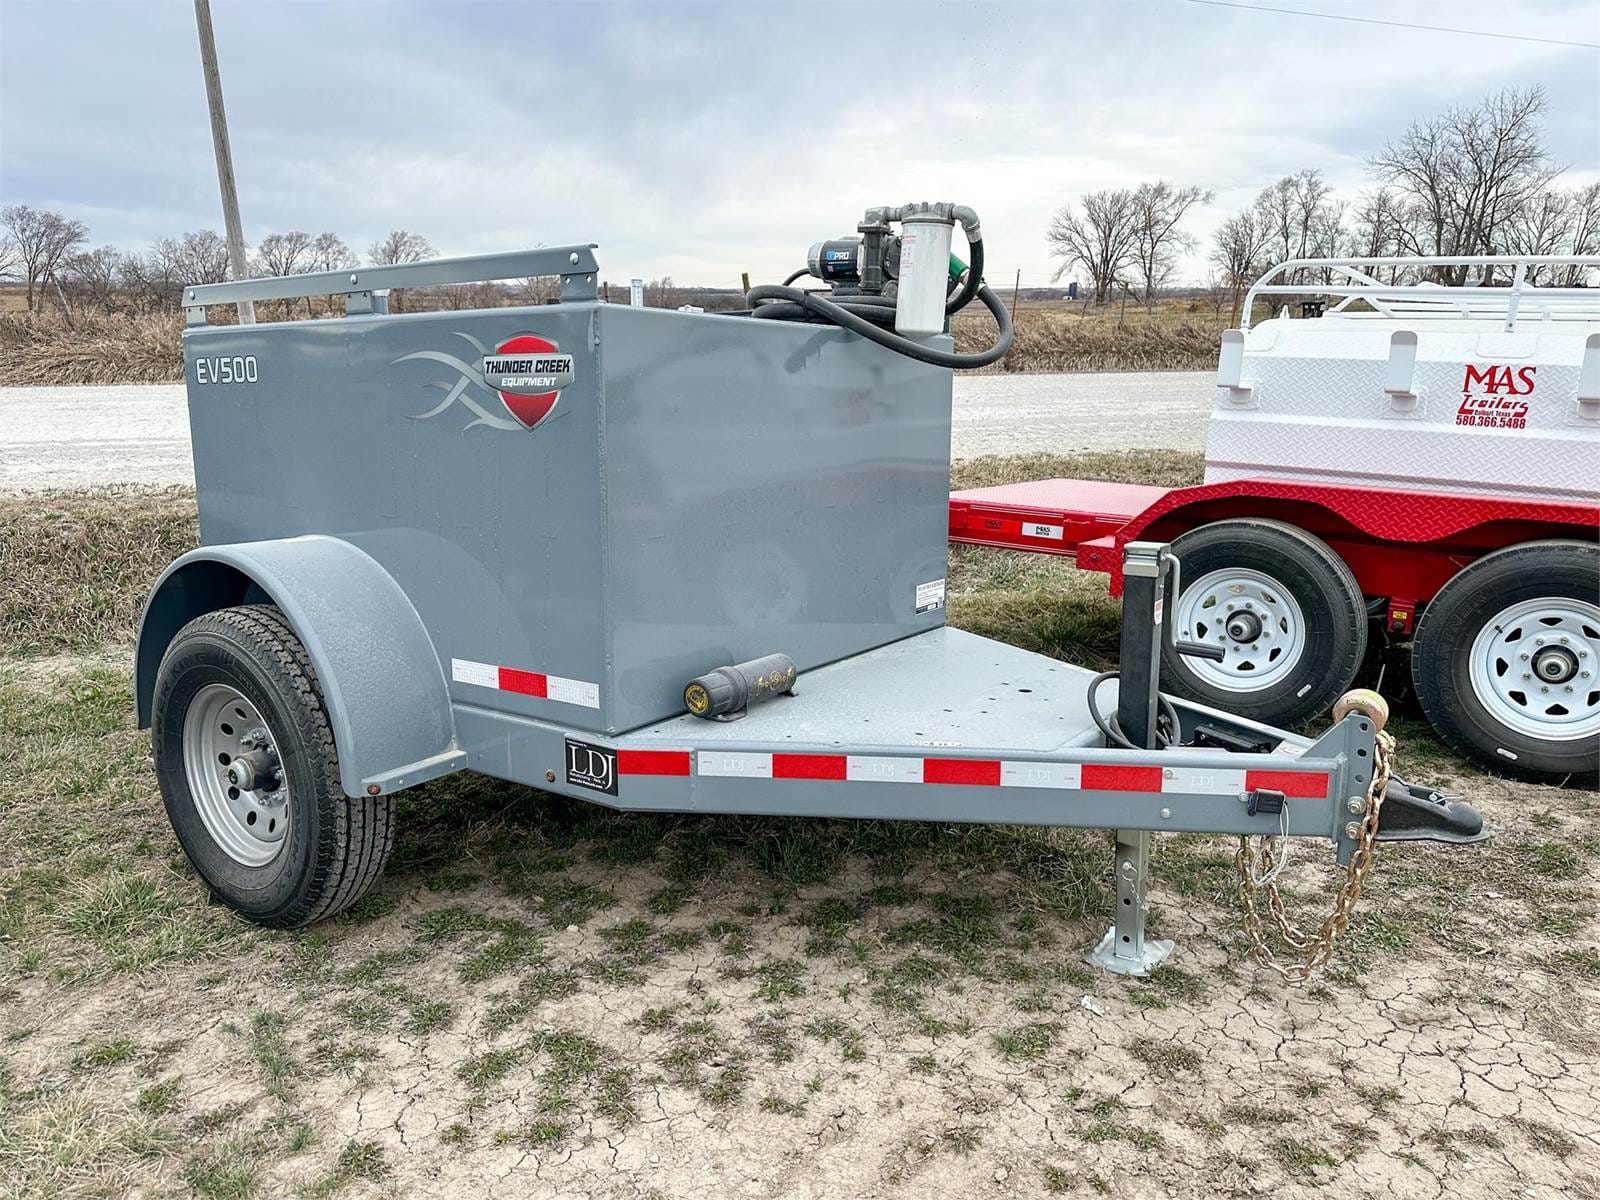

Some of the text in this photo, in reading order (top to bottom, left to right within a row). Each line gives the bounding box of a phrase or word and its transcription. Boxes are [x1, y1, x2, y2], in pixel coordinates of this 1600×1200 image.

[195, 355, 259, 385] EV500
[485, 358, 572, 375] THUNDER CREEK
[501, 376, 557, 388] EQUIPMENT
[1461, 364, 1537, 396] MAS
[1457, 394, 1530, 418] Trailers
[1455, 414, 1527, 430] 580.366.5488
[568, 744, 617, 790] LDJ
